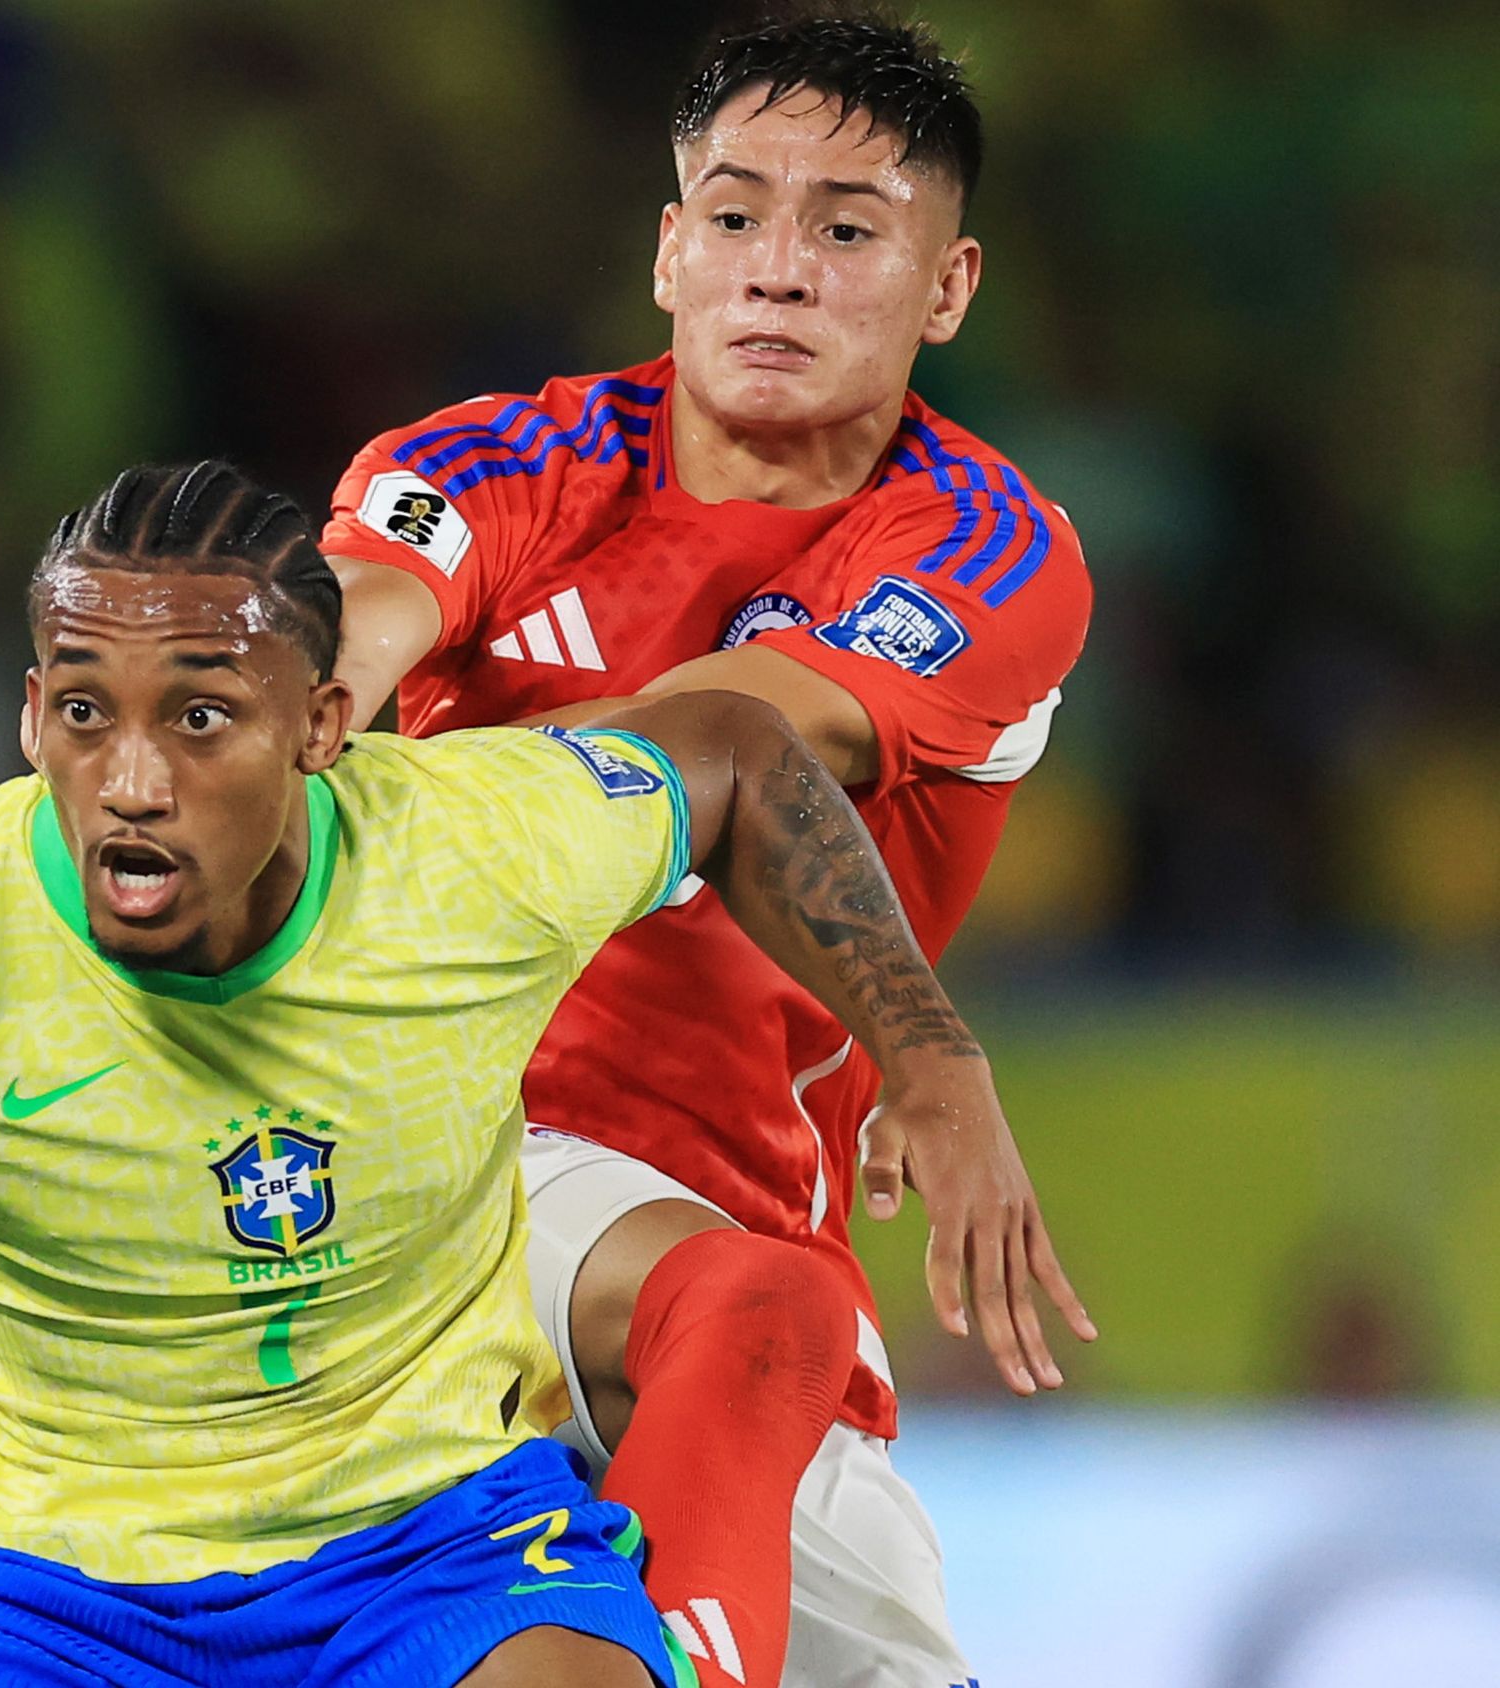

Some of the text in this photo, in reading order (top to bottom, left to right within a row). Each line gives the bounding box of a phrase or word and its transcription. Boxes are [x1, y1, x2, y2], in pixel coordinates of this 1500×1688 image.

[722, 597, 773, 650] EDERACION
[779, 598, 794, 614] DE
[868, 605, 932, 658] UNITES
[883, 594, 941, 646] FOOTBALL
[255, 1177, 299, 1197] CBF
[228, 1242, 355, 1285] BRASIL
[240, 1282, 321, 1386] 7
